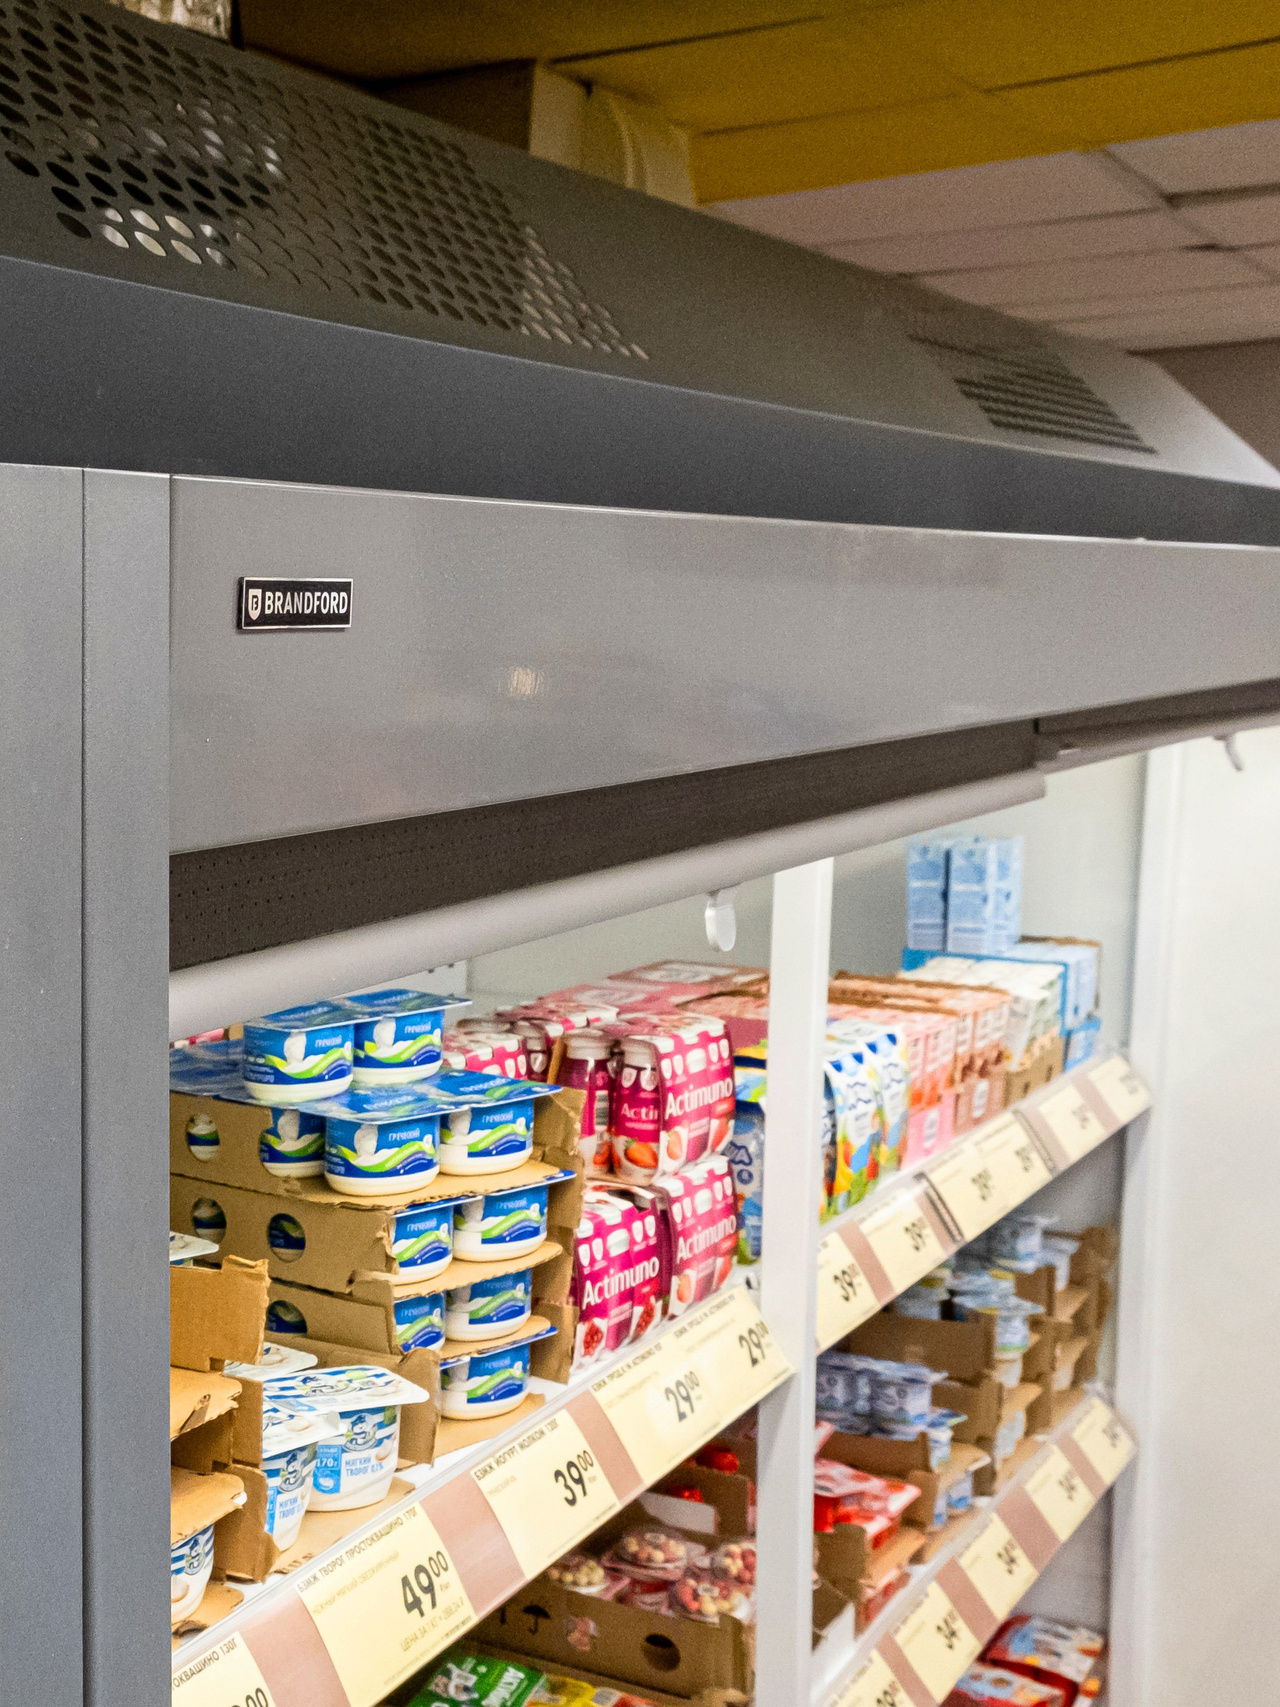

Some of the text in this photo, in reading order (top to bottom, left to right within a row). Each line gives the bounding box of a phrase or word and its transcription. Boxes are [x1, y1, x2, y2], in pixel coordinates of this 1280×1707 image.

[265, 591, 348, 614] BRANDFORD
[665, 1077, 733, 1120] Actimuno
[677, 1215, 737, 1264] Actimuno
[583, 1257, 660, 1310] Actimuno
[318, 1554, 346, 1578] ТВОРОГ
[344, 1515, 404, 1561] ПРОСТОКВАШИНО
[172, 1651, 220, 1690] ОКВАШИНО
